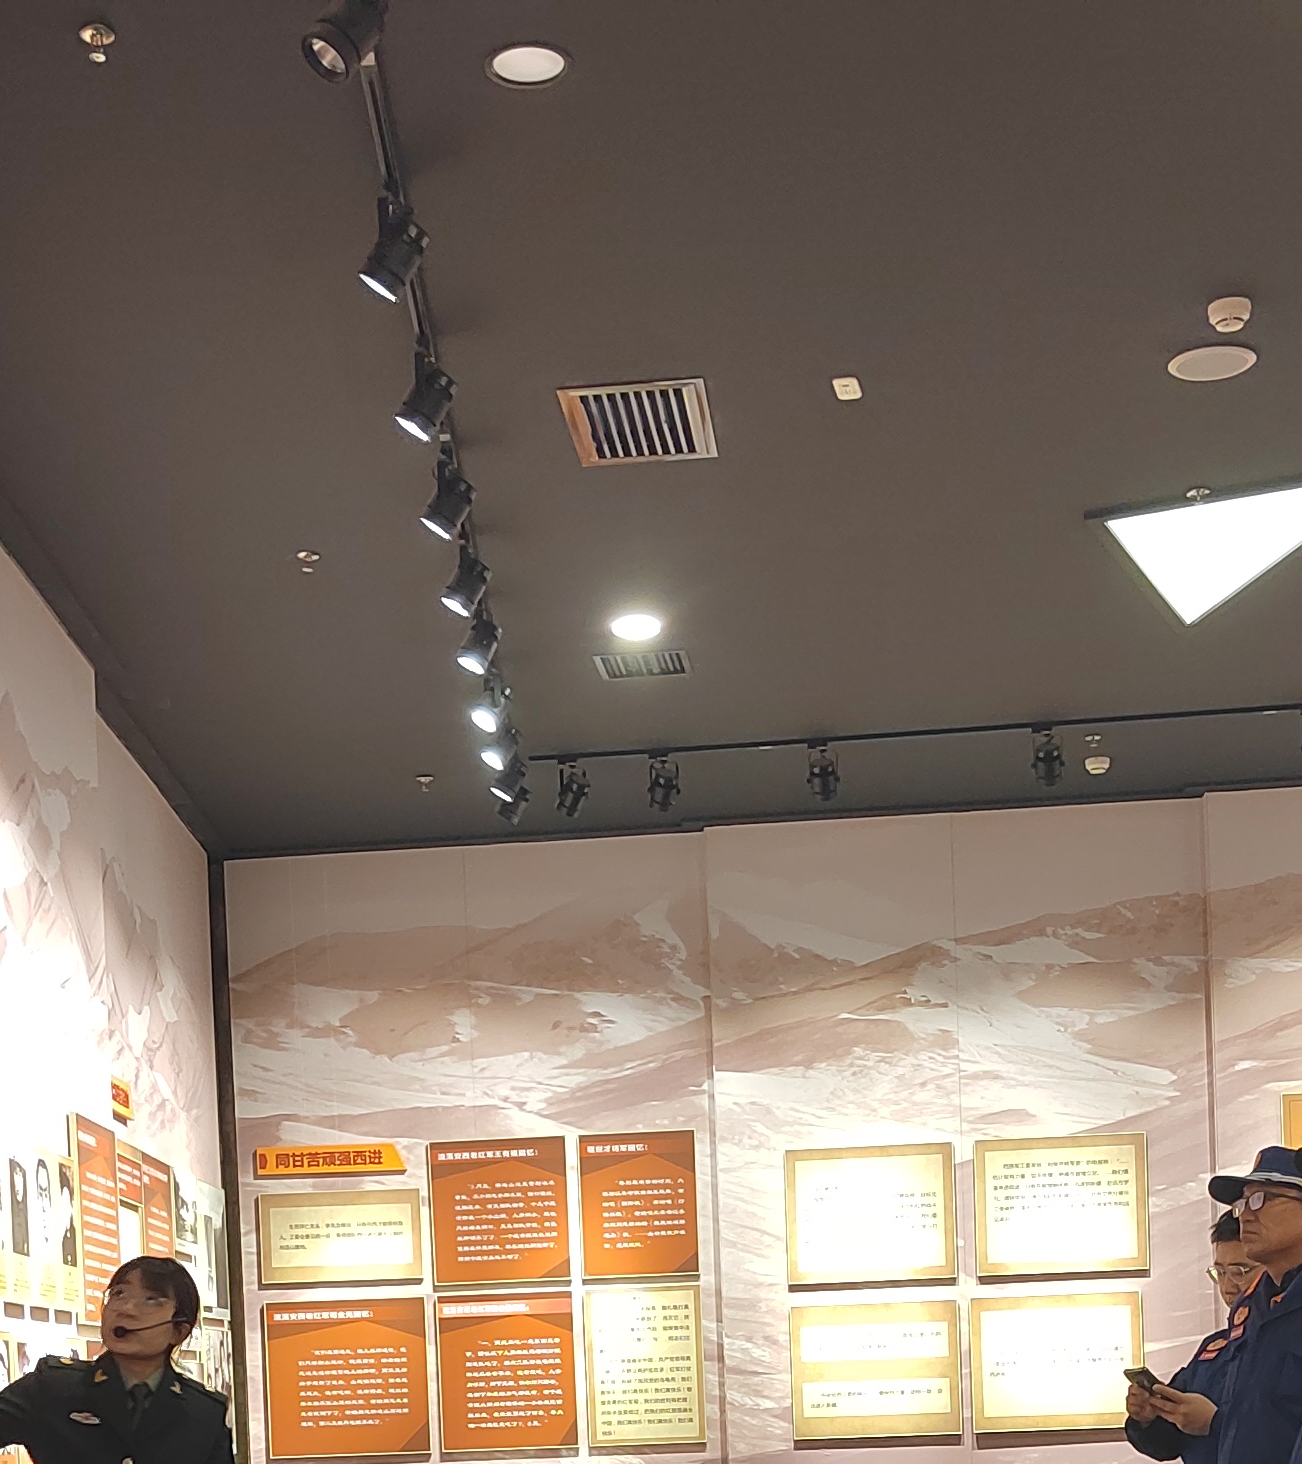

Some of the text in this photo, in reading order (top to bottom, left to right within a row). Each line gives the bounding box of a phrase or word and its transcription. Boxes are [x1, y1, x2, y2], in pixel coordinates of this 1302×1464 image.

[275, 1149, 382, 1169] 同甘苦顽强西进
